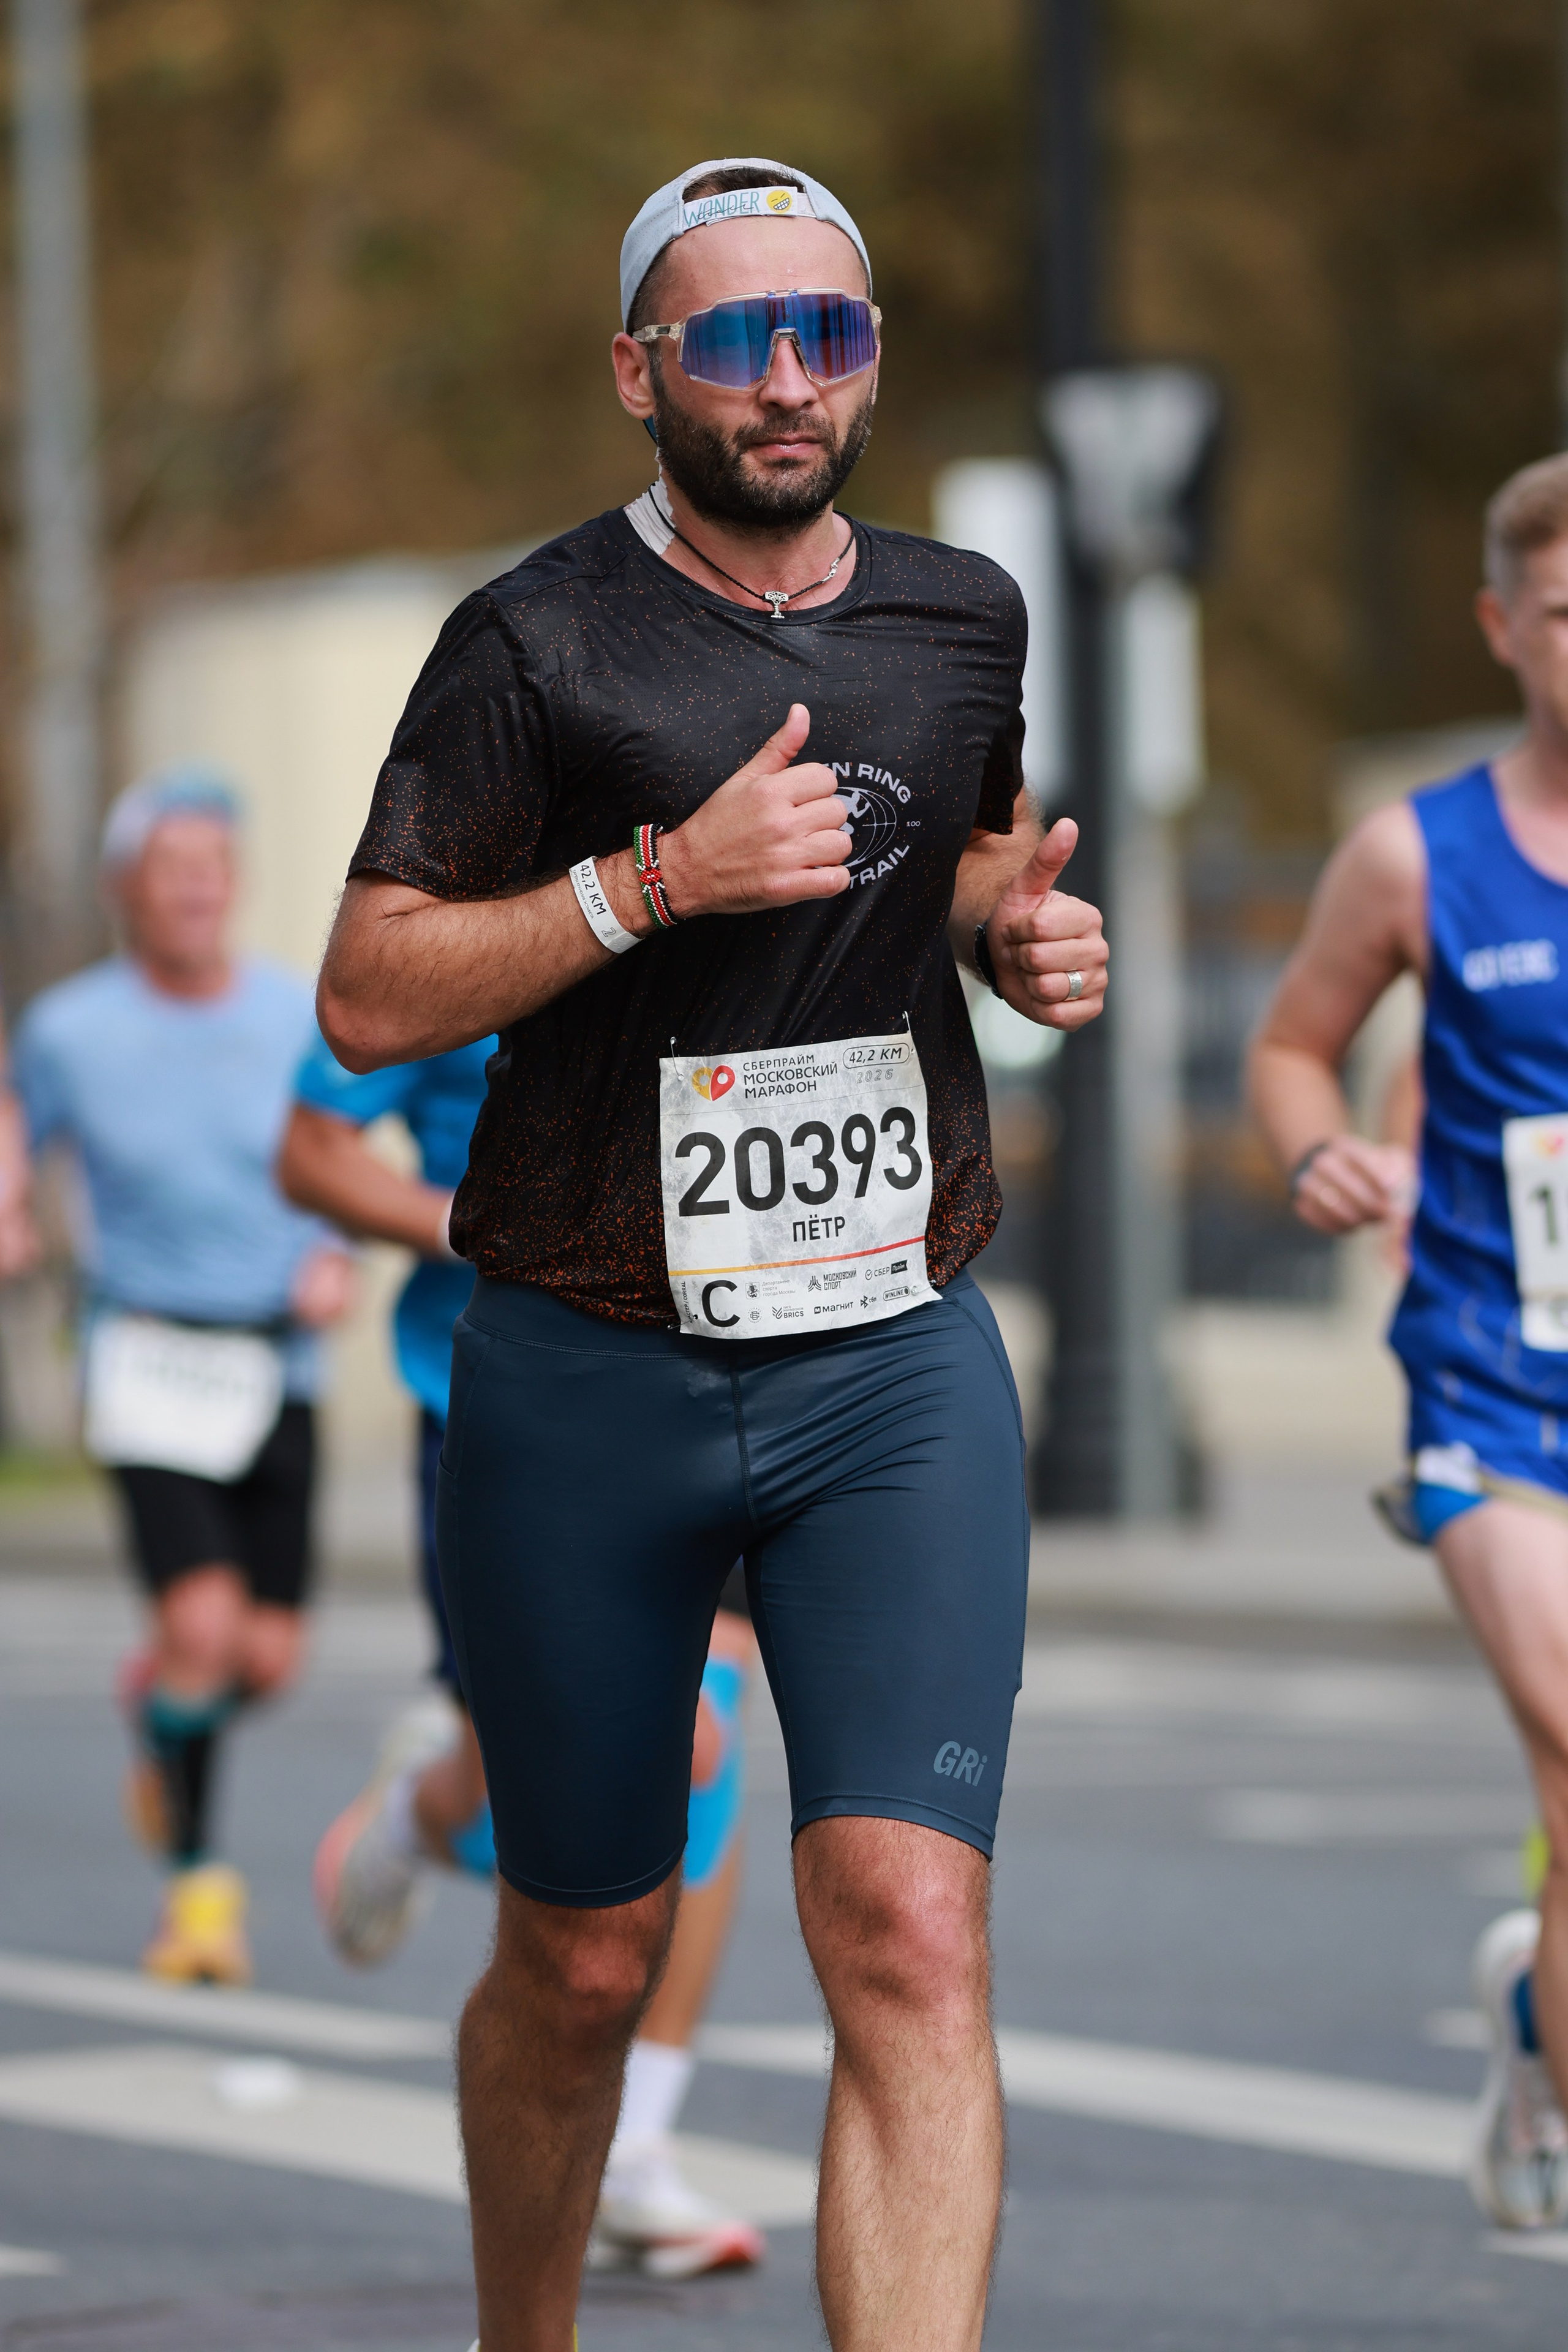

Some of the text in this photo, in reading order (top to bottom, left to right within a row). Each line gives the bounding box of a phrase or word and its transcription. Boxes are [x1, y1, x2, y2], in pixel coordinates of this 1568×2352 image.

[683, 191, 760, 227] WONDER
[858, 763, 911, 804] RING
[848, 845, 910, 889] TRAIL
[580, 865, 595, 890] 42,2
[601, 927, 616, 937] 2
[743, 1054, 815, 1071] СБЕРПРАЙМ
[850, 1049, 875, 1063] 42,2
[744, 1061, 838, 1085] МОСКОВСКИЙ
[857, 1069, 893, 1084] 2026
[745, 1080, 817, 1099] МАРАФОН
[675, 1106, 922, 1217] 20393
[793, 1215, 846, 1242] ПЁТР
[823, 1268, 857, 1282] МОСКОВСКИЙ
[874, 1267, 890, 1276] СБЕР
[824, 1281, 841, 1291] СПОРТ
[885, 1289, 903, 1299] WINLINE
[933, 1741, 988, 1787] GRi
